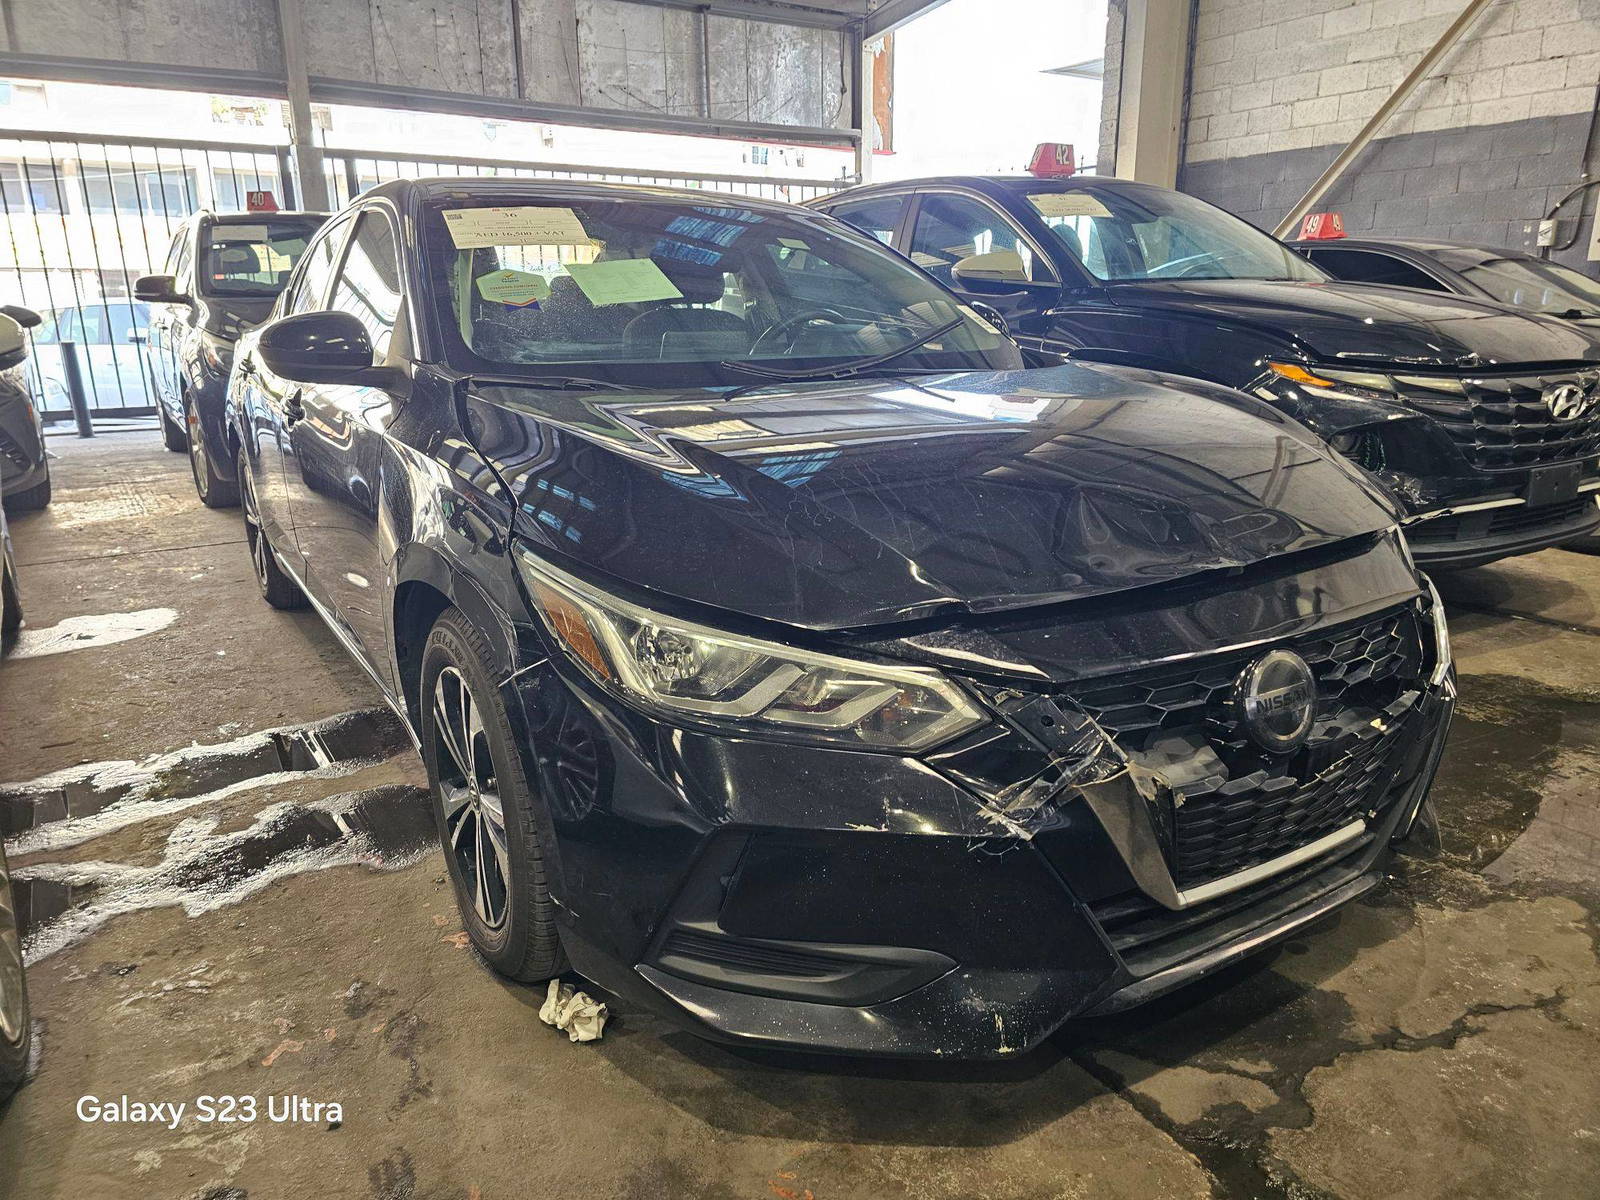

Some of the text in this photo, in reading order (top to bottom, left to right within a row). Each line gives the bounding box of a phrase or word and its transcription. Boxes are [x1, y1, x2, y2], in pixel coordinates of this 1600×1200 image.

[1056, 144, 1070, 165] 42
[251, 191, 264, 206] 40
[1304, 215, 1319, 233] 49
[1256, 687, 1307, 713] NISSAN
